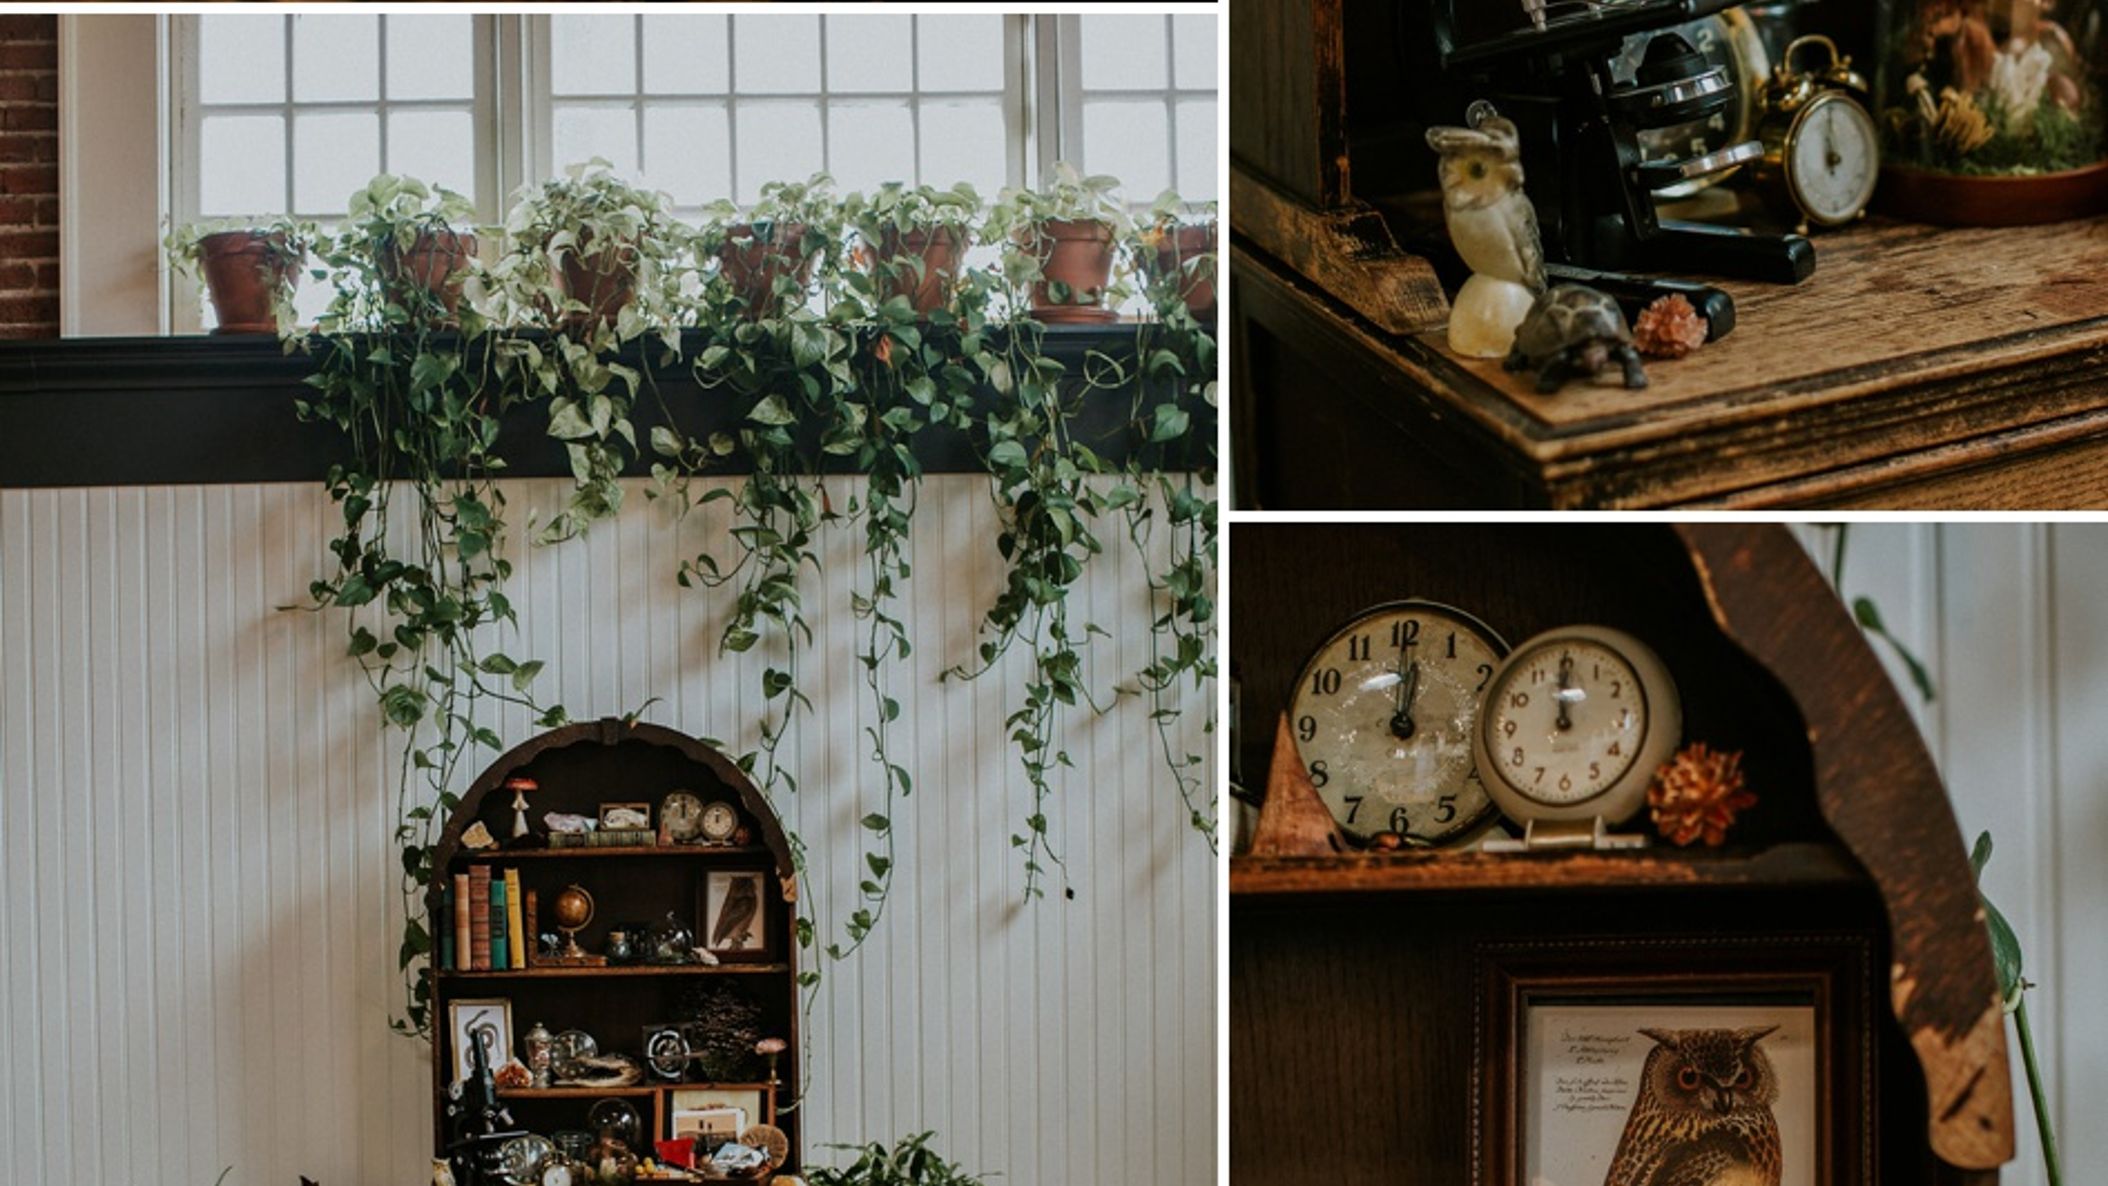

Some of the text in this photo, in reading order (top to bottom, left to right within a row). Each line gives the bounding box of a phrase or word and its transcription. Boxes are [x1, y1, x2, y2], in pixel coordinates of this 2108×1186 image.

[1697, 28, 1715, 53] 2
[1691, 138, 1707, 157] 5
[1390, 620, 1420, 647] 12
[1349, 635, 1371, 661] 11
[1446, 631, 1457, 659] 1
[1311, 668, 1341, 695] 10
[1532, 669, 1545, 685] 11
[1594, 664, 1599, 681] 1
[1511, 692, 1529, 708] 10
[1610, 681, 1620, 698] 2
[1298, 716, 1317, 742] 9
[1504, 721, 1517, 739] 9
[1512, 746, 1524, 767] 8
[1607, 741, 1620, 756] 4
[1310, 760, 1329, 788] 8
[1535, 767, 1545, 784] 7
[1589, 762, 1600, 779] 5
[1558, 774, 1571, 791] 6
[1344, 796, 1363, 824] 7
[1434, 794, 1457, 823] 5
[1389, 807, 1409, 833] 6
